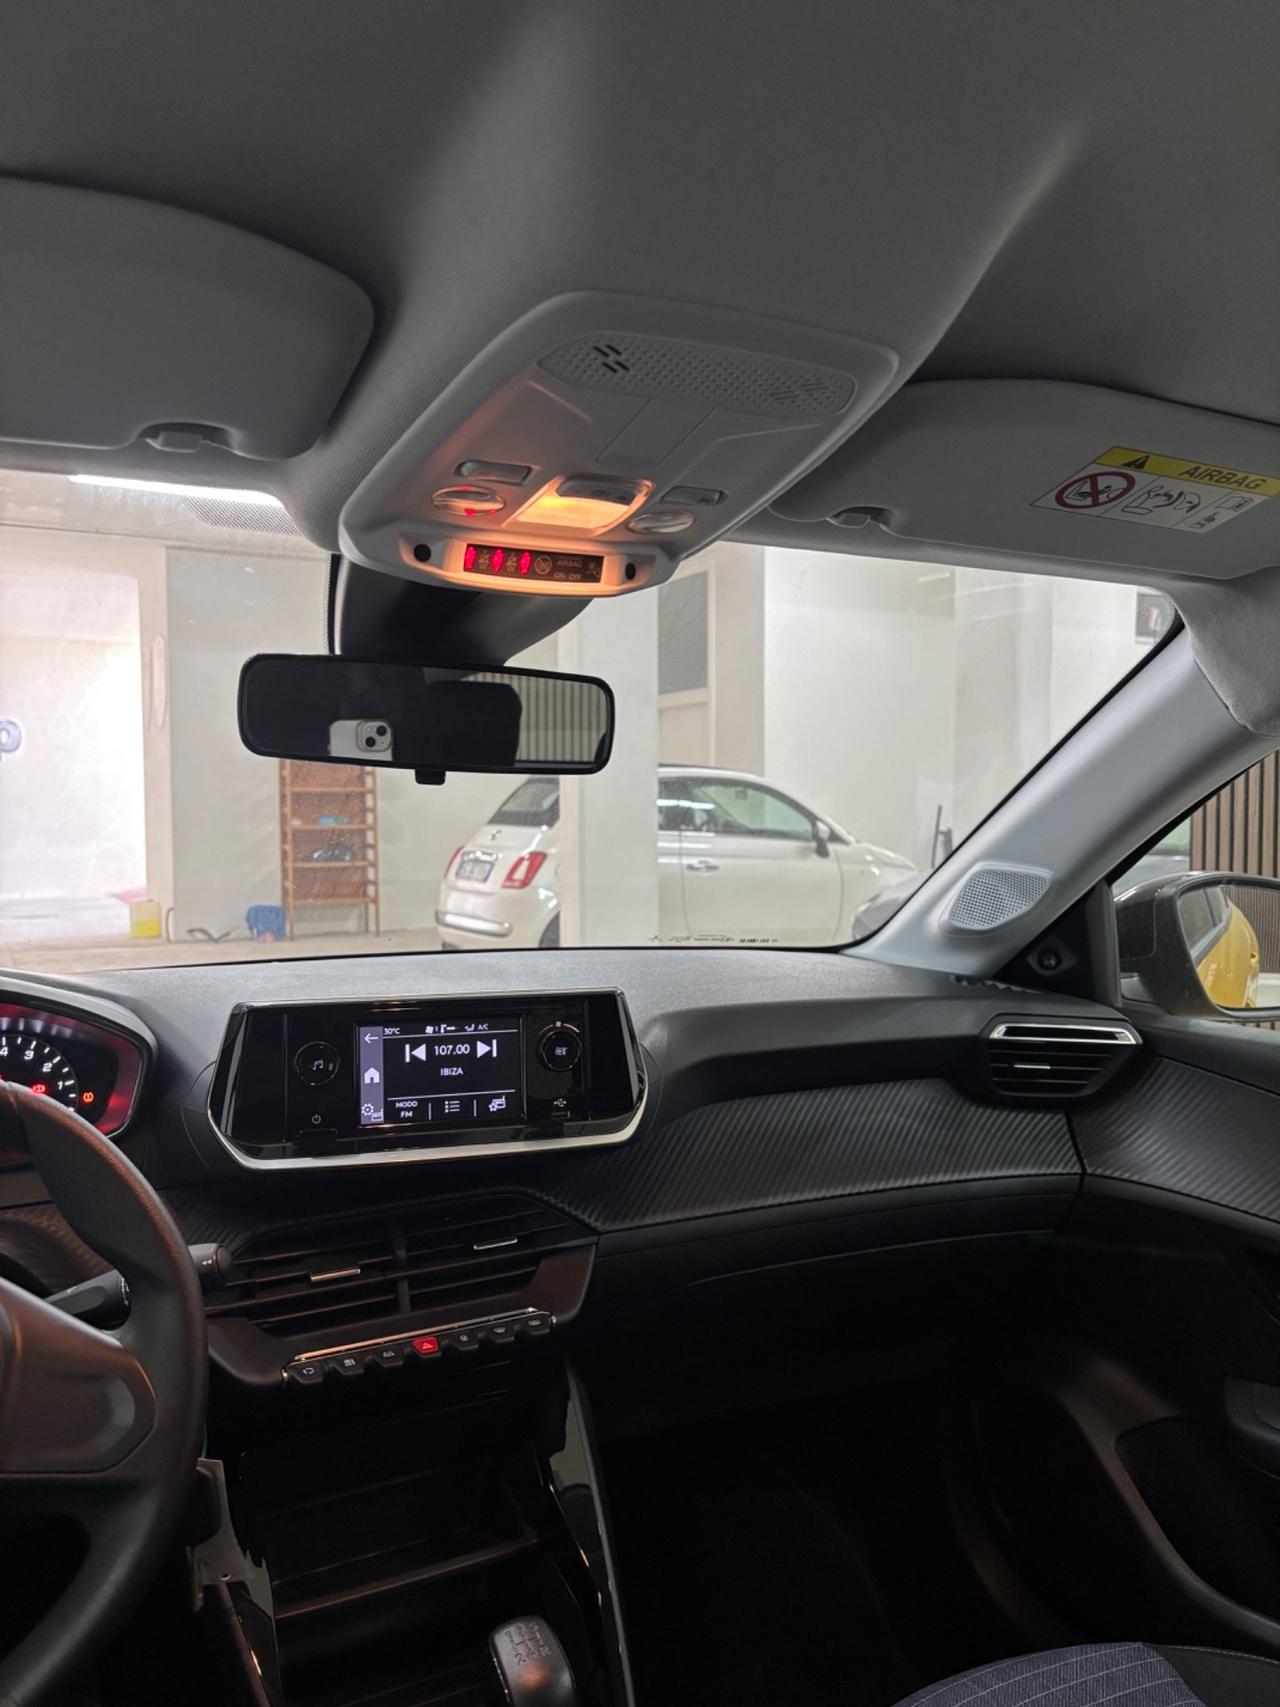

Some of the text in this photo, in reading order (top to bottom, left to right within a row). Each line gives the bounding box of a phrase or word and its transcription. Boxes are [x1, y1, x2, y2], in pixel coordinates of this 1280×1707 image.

[1178, 466, 1267, 489] AIRBAG
[0, 1046, 8, 1057] 4
[24, 1050, 35, 1060] 3
[434, 1044, 471, 1056] 107.00
[42, 1062, 53, 1072] 2
[440, 1067, 464, 1076] IBIZA
[57, 1081, 63, 1090] 1
[400, 1110, 413, 1118] FM
